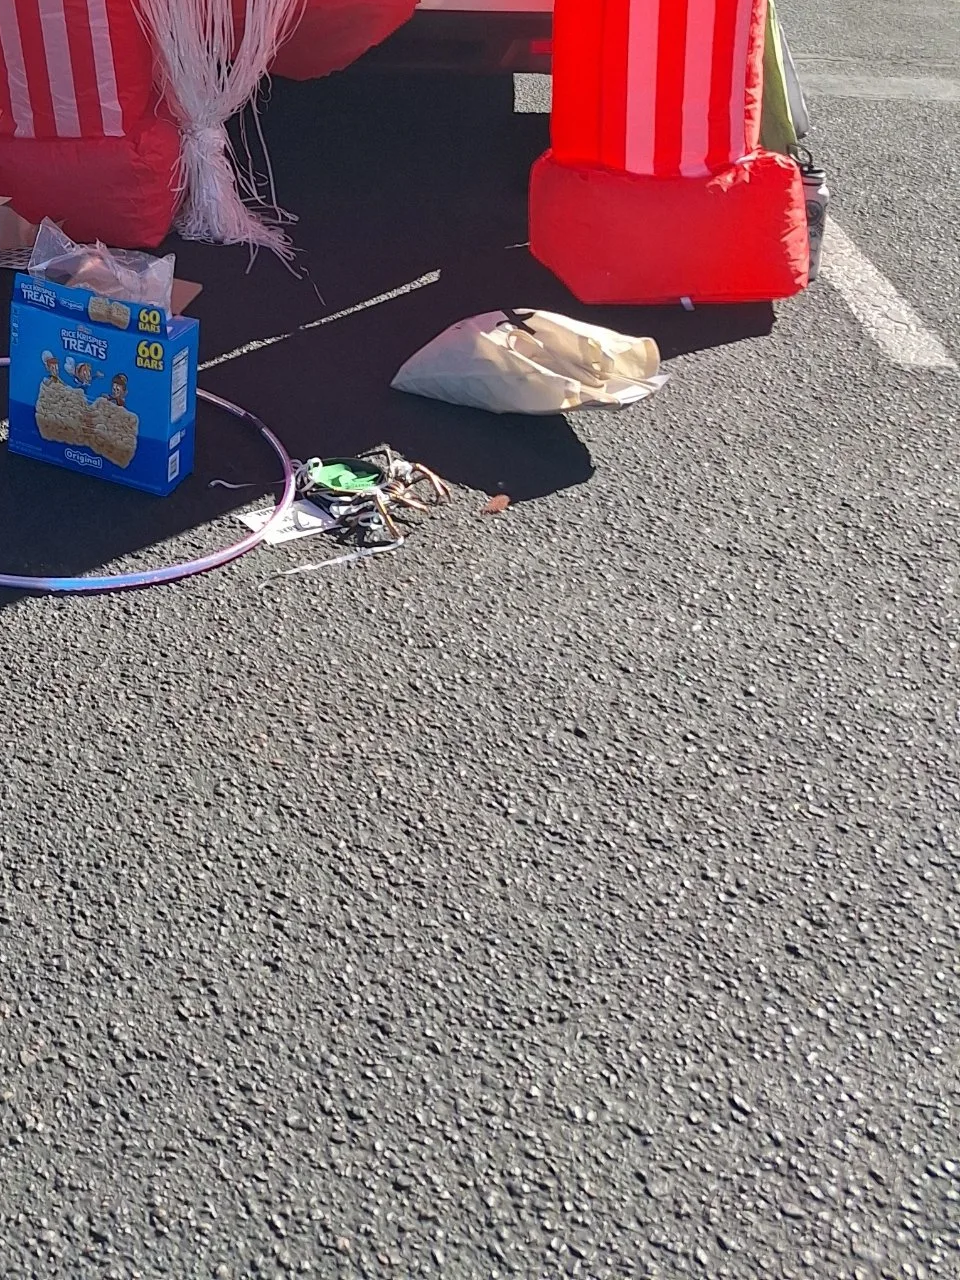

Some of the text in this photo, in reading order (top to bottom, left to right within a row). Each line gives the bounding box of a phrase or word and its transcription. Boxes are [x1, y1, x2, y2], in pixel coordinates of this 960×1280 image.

[21, 288, 56, 308] TREATS
[139, 308, 161, 326] 60
[138, 321, 161, 334] BARS
[61, 329, 76, 339] RICE
[76, 330, 108, 349] KRISPIES
[62, 336, 107, 360] TREATS
[137, 340, 164, 361] 60
[136, 356, 164, 371] BARS
[66, 449, 102, 468] Original
